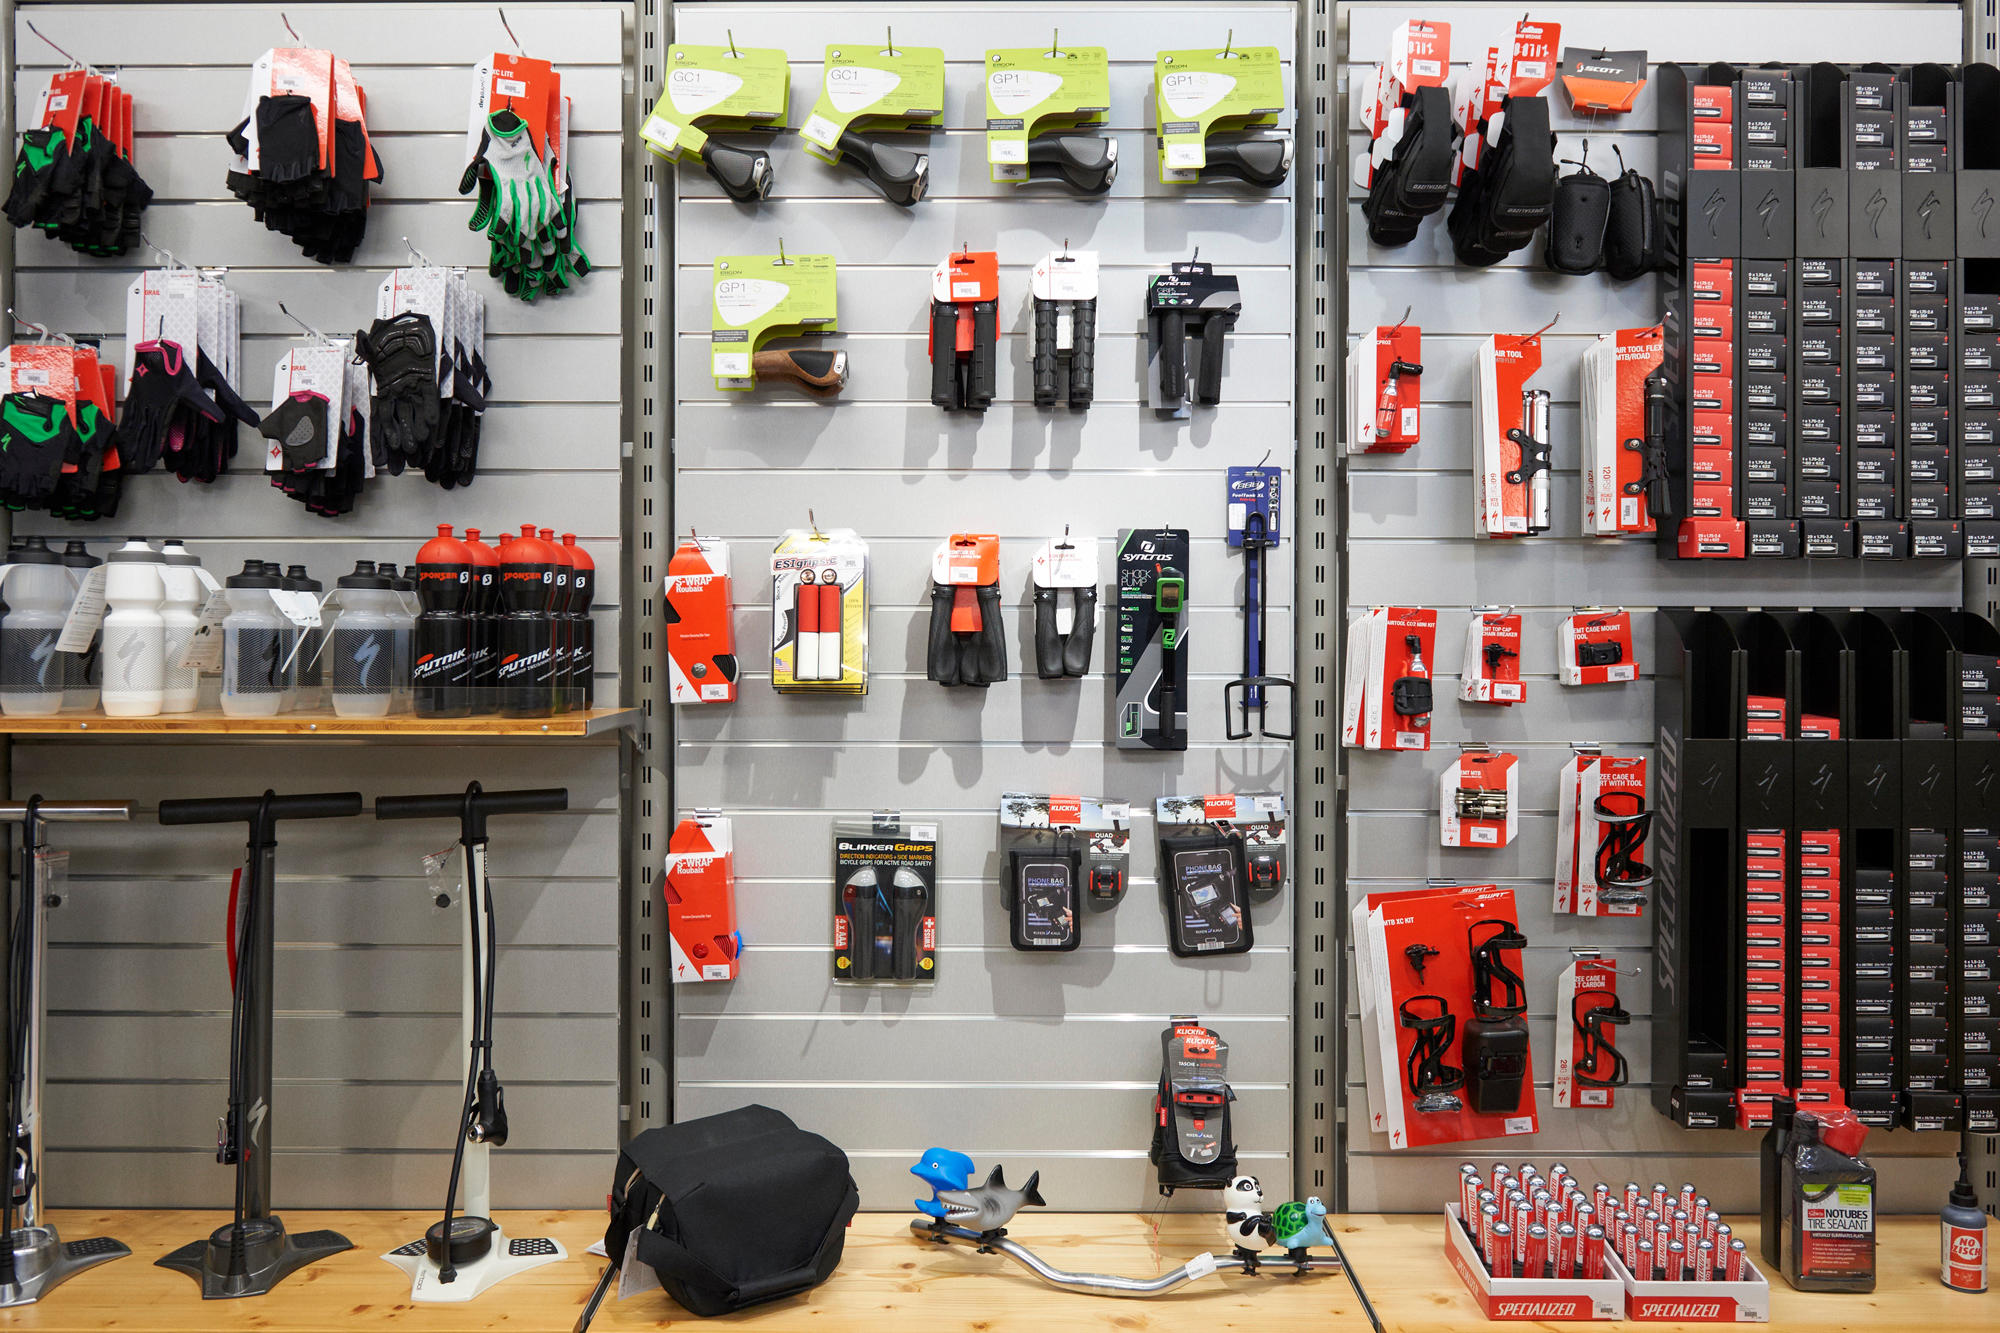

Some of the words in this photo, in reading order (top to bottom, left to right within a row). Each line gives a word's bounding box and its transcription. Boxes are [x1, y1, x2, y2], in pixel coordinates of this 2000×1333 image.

[674, 71, 701, 83] GC1
[832, 70, 858, 81] GC1
[993, 74, 1019, 84] GP1
[1166, 75, 1193, 86] GP1
[720, 283, 745, 294] GP1
[420, 572, 457, 581] SPONSER
[504, 572, 541, 581] SPONSER
[1122, 570, 1151, 579] SHOCK
[676, 577, 712, 586] S-WRAP
[1121, 578, 1147, 587] PUMP
[414, 648, 466, 678] SPUTNIK
[499, 648, 551, 678] SPUTNIK
[839, 842, 893, 852] BLINKER
[894, 844, 933, 852] GRIPS
[677, 858, 713, 868] S-WRAP
[1659, 726, 1678, 1006] SPECIALIZED
[677, 866, 704, 874] Roubaix
[1186, 1037, 1214, 1046] KLICKfix
[1826, 1209, 1868, 1219] NOTUBES
[1808, 1219, 1825, 1229] TIRE
[1827, 1219, 1868, 1230] SEALANT
[1959, 1238, 1975, 1247] NO
[1952, 1246, 1981, 1258] ZISCH
[1496, 1303, 1576, 1319] SPECIALIZED
[1640, 1304, 1720, 1320] SPECIALIZED
